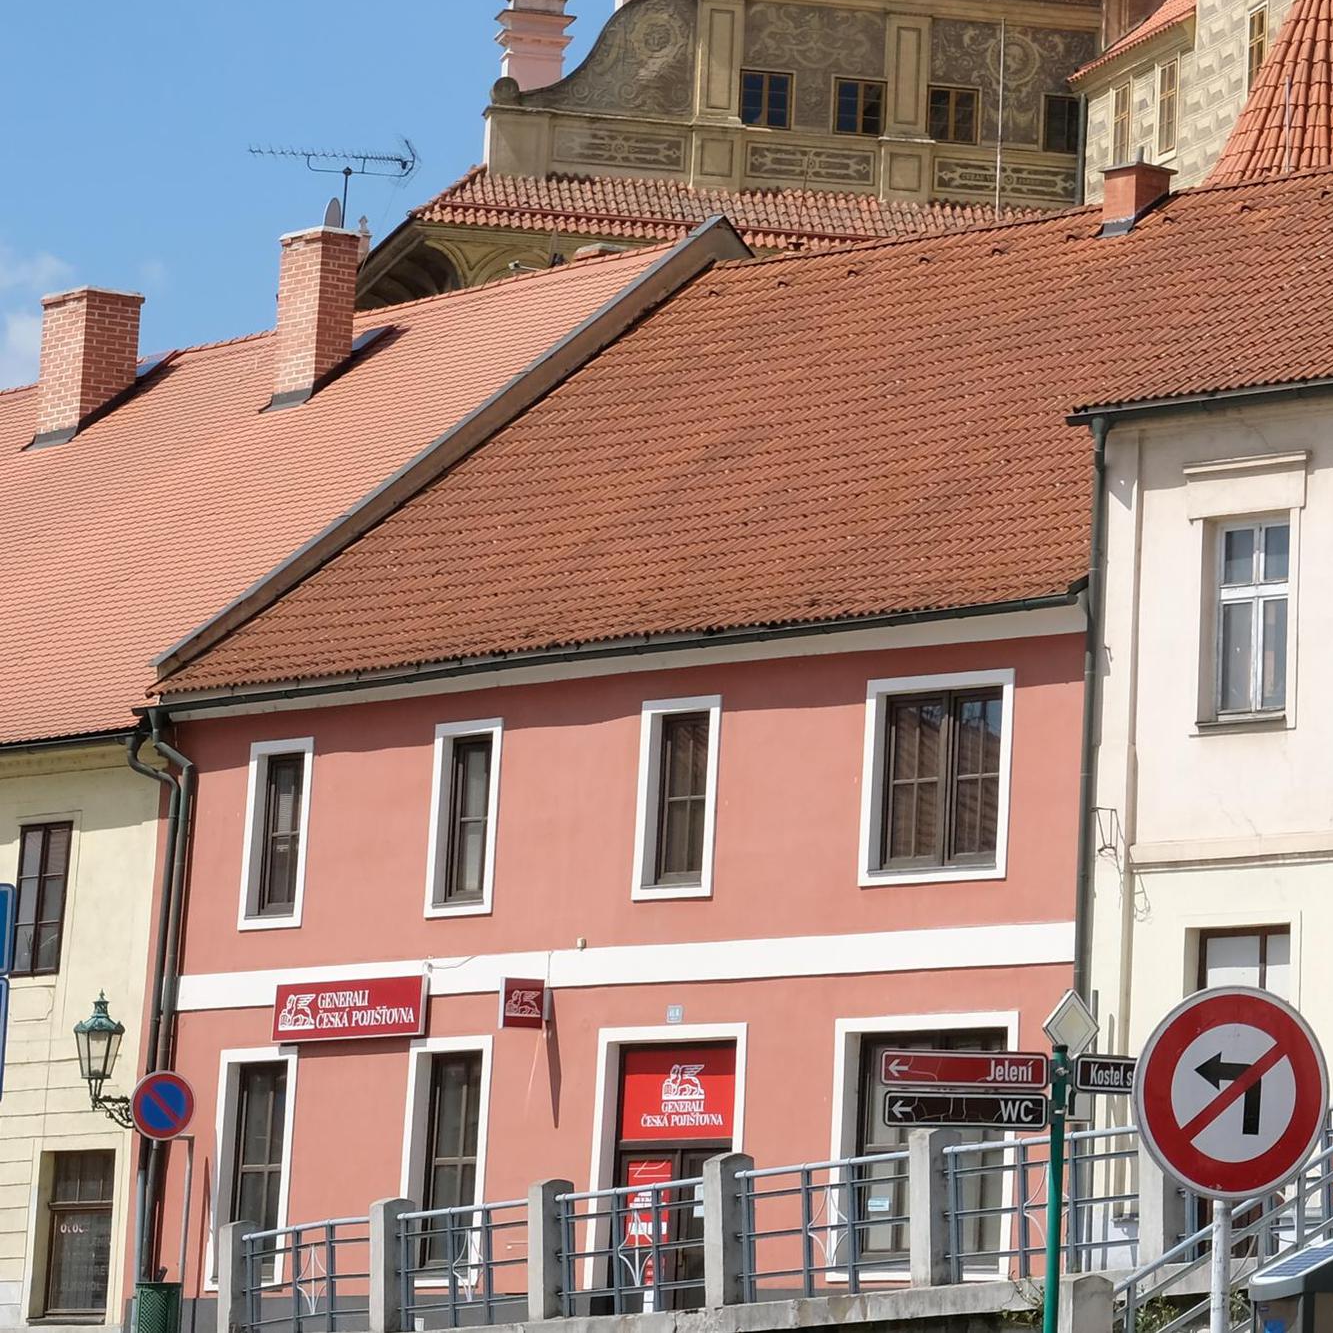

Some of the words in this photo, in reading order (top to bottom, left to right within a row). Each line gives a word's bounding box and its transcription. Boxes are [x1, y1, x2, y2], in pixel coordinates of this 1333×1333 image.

[317, 990, 369, 1008] GENERALI
[316, 1007, 349, 1029] ČESKÁ
[351, 1006, 415, 1027] POJIŠŤOVNA
[986, 1060, 1033, 1083] Jelení
[1090, 1063, 1124, 1087] Kostel
[661, 1100, 704, 1113] GENERALI
[1000, 1100, 1034, 1122] WC
[641, 1112, 669, 1127] ČESKÁ
[670, 1111, 724, 1127] POJIŠŤOVNA
